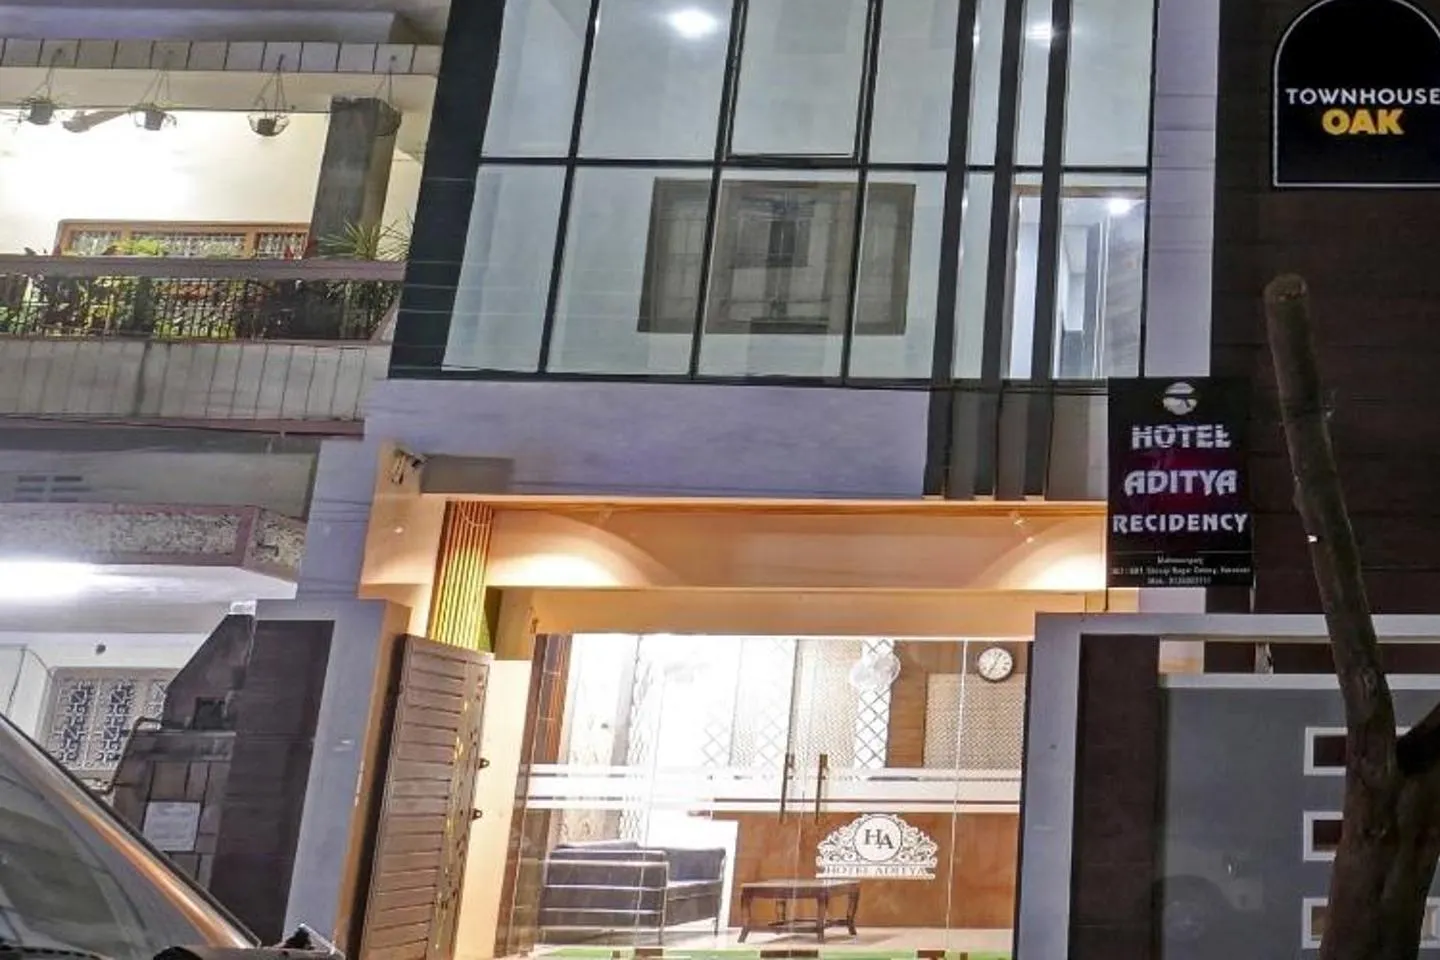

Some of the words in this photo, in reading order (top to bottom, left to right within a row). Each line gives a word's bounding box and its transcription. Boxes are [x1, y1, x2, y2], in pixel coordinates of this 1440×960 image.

[1322, 108, 1404, 135] OAK
[1132, 424, 1231, 449] HOTEL
[1124, 470, 1237, 496] ADITYA
[1112, 514, 1248, 533] RECIDENCY
